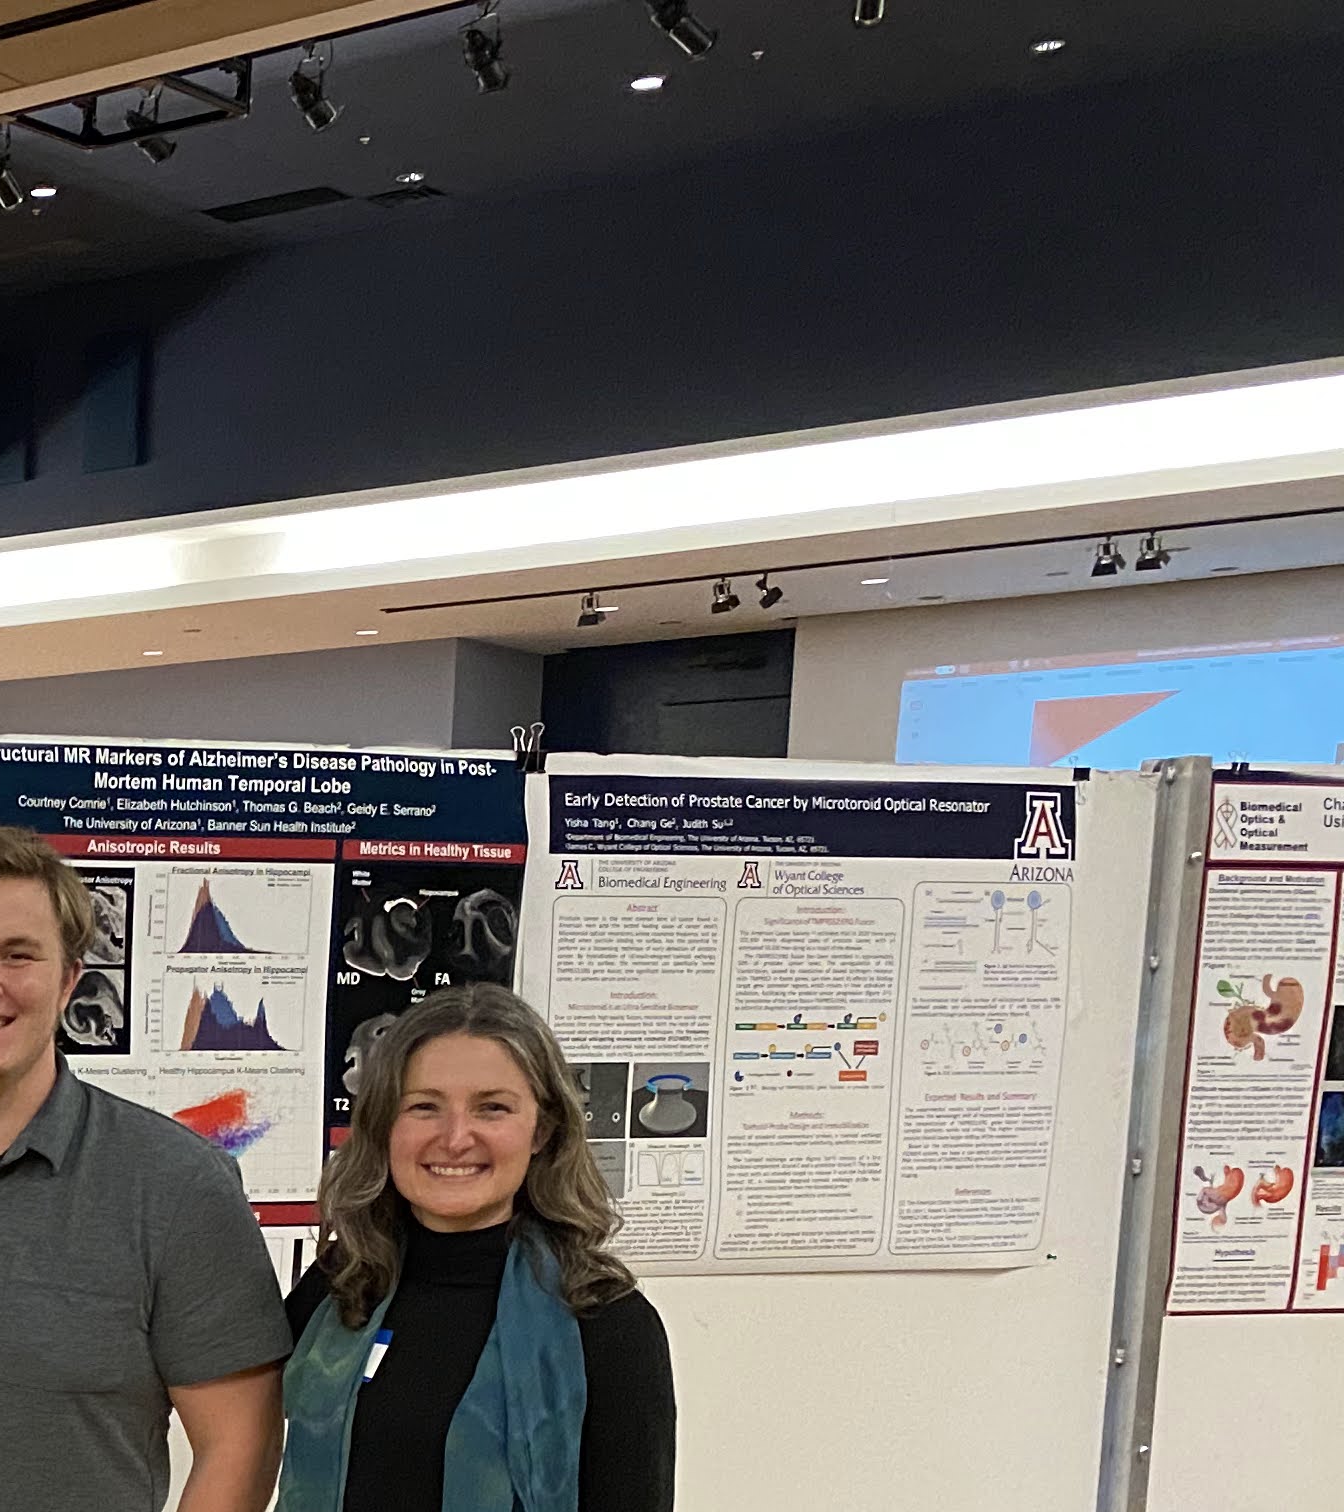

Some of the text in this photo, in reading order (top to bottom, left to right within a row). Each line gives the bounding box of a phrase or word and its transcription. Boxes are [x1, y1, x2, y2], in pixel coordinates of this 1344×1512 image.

[64, 747, 91, 764] MR
[96, 748, 162, 766] Markers
[168, 750, 185, 766] of
[189, 750, 288, 768] Alzheimer's
[361, 755, 436, 777] Pathology
[440, 759, 454, 774] in
[458, 760, 497, 776] Post-
[94, 771, 351, 796] Mortem Human Temporal Lobe
[18, 795, 66, 811] Courtney
[117, 798, 167, 811] Elizabeth
[242, 800, 286, 813] Thomas
[288, 801, 302, 813] G.
[347, 803, 378, 818] Geidy
[380, 803, 391, 815] E.
[565, 793, 991, 814] Early Detection of Prostate Cancer by Microtoroid Optical Resonator
[1240, 801, 1302, 812] Biomedical
[63, 816, 83, 828] The
[86, 817, 139, 832] University
[141, 818, 153, 830] of
[208, 819, 248, 831] Banner
[250, 819, 271, 832] Sun
[273, 821, 308, 832] Health
[1240, 814, 1285, 825] Optics &
[1240, 828, 1278, 839] Optical
[87, 839, 220, 856] Anisotropic Results
[360, 841, 512, 860] Metrics in Healthy Tissue
[1239, 841, 1308, 851] Measurement
[774, 870, 844, 884] Wyant College
[1009, 865, 1074, 882] ARIZONA
[598, 876, 727, 892] Biomedical Engineering
[772, 884, 865, 898] of Optical Sciences
[337, 972, 360, 985] MD
[435, 972, 450, 985] FA
[333, 1098, 350, 1111] T2
